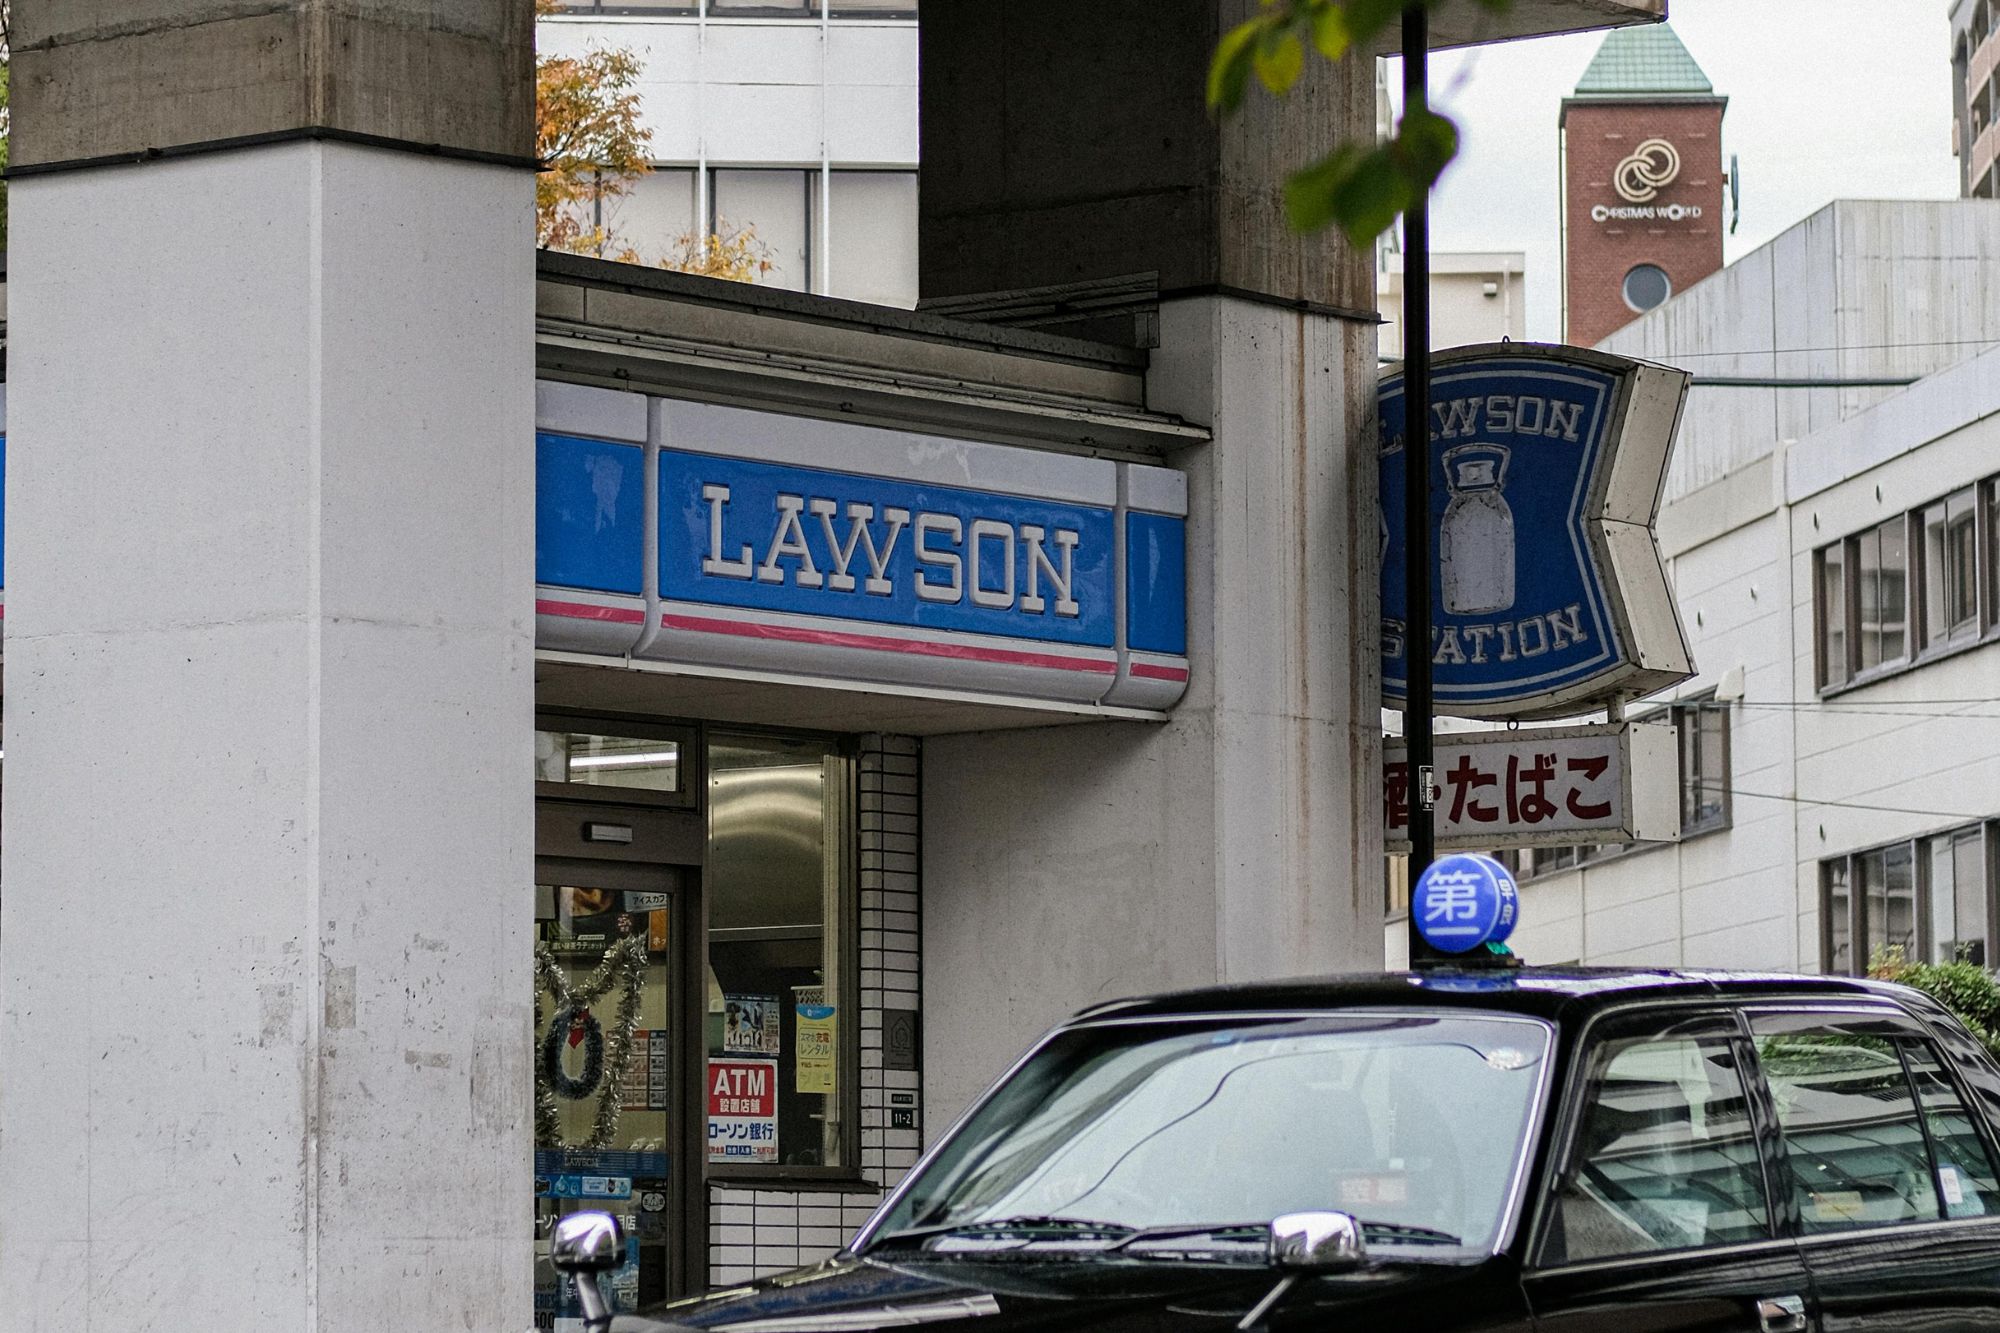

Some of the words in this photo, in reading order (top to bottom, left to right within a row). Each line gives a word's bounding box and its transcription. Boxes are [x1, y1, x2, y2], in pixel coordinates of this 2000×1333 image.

[1591, 204, 1655, 222] CHRISTMAS
[701, 482, 1080, 618] LAWSON
[1380, 602, 1588, 665] SATION
[1424, 869, 1482, 936] 第一
[800, 1044, 830, 1056] レンタル
[713, 1068, 766, 1096] ATM
[719, 1098, 761, 1114] 設置店舗
[895, 1113, 911, 1124] 11-2
[708, 1122, 774, 1140] ローソン銀行
